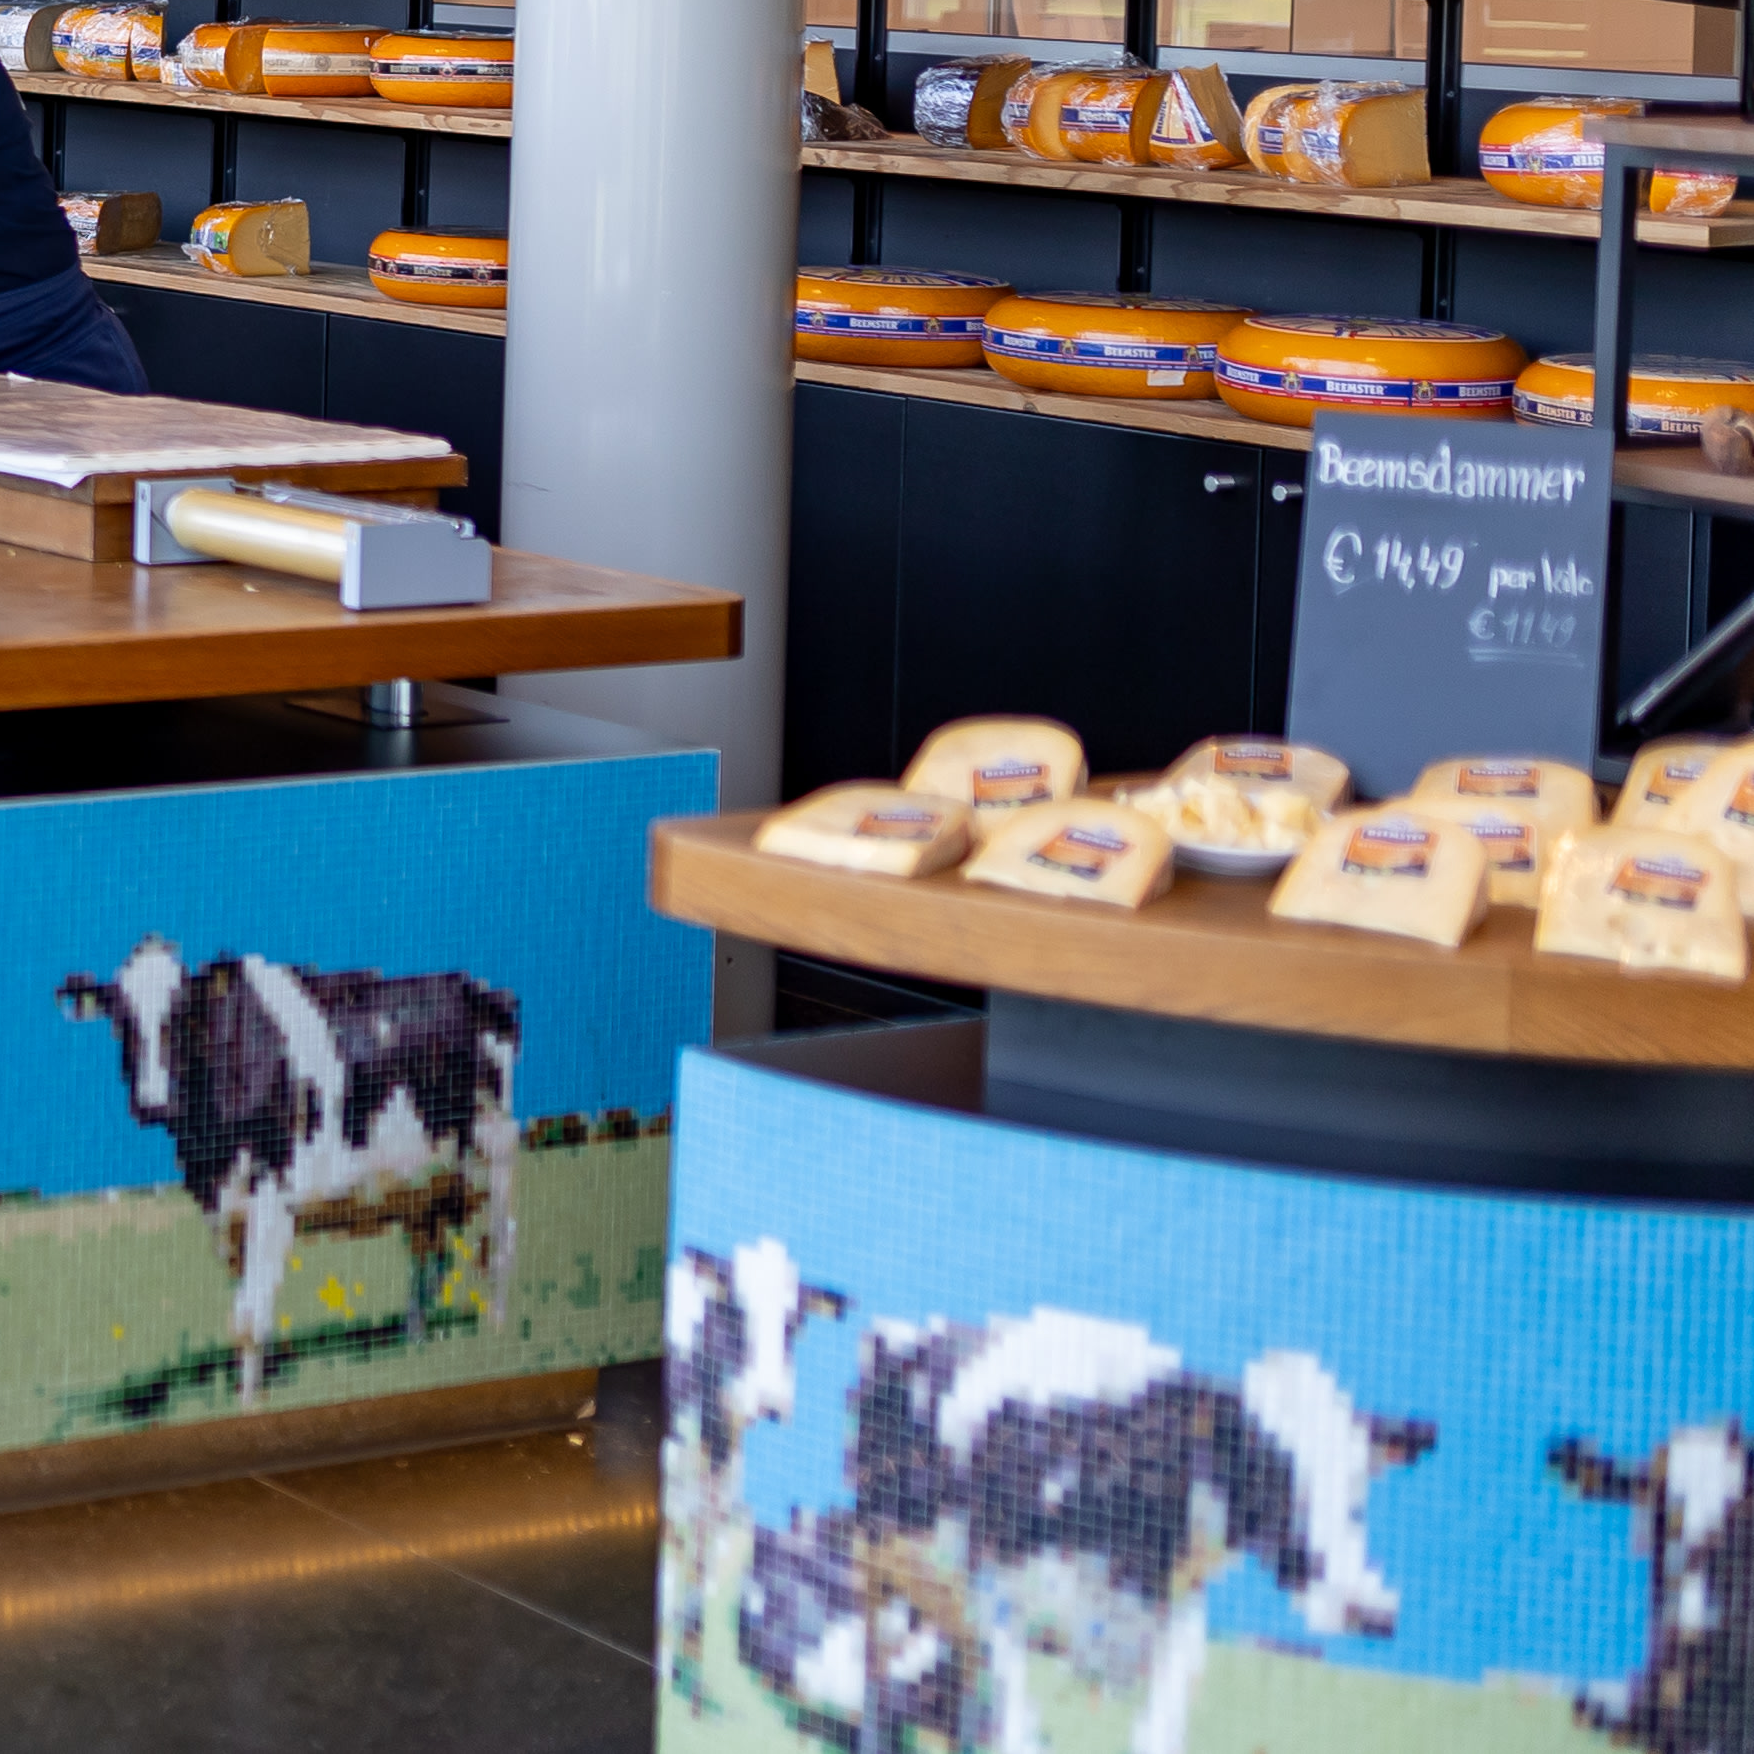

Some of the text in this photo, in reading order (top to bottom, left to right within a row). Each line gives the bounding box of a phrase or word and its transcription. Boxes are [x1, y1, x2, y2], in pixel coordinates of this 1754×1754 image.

[850, 319, 899, 330] BEEMSTER
[1104, 346, 1156, 359] BEEMSTER
[1326, 380, 1385, 395] BEEMSTER
[1459, 385, 1501, 398] BEEMSTER
[1319, 441, 1586, 503] Beemsdammer
[1323, 526, 1363, 584] €
[1487, 566, 1536, 599] per
[1469, 609, 1495, 640] €
